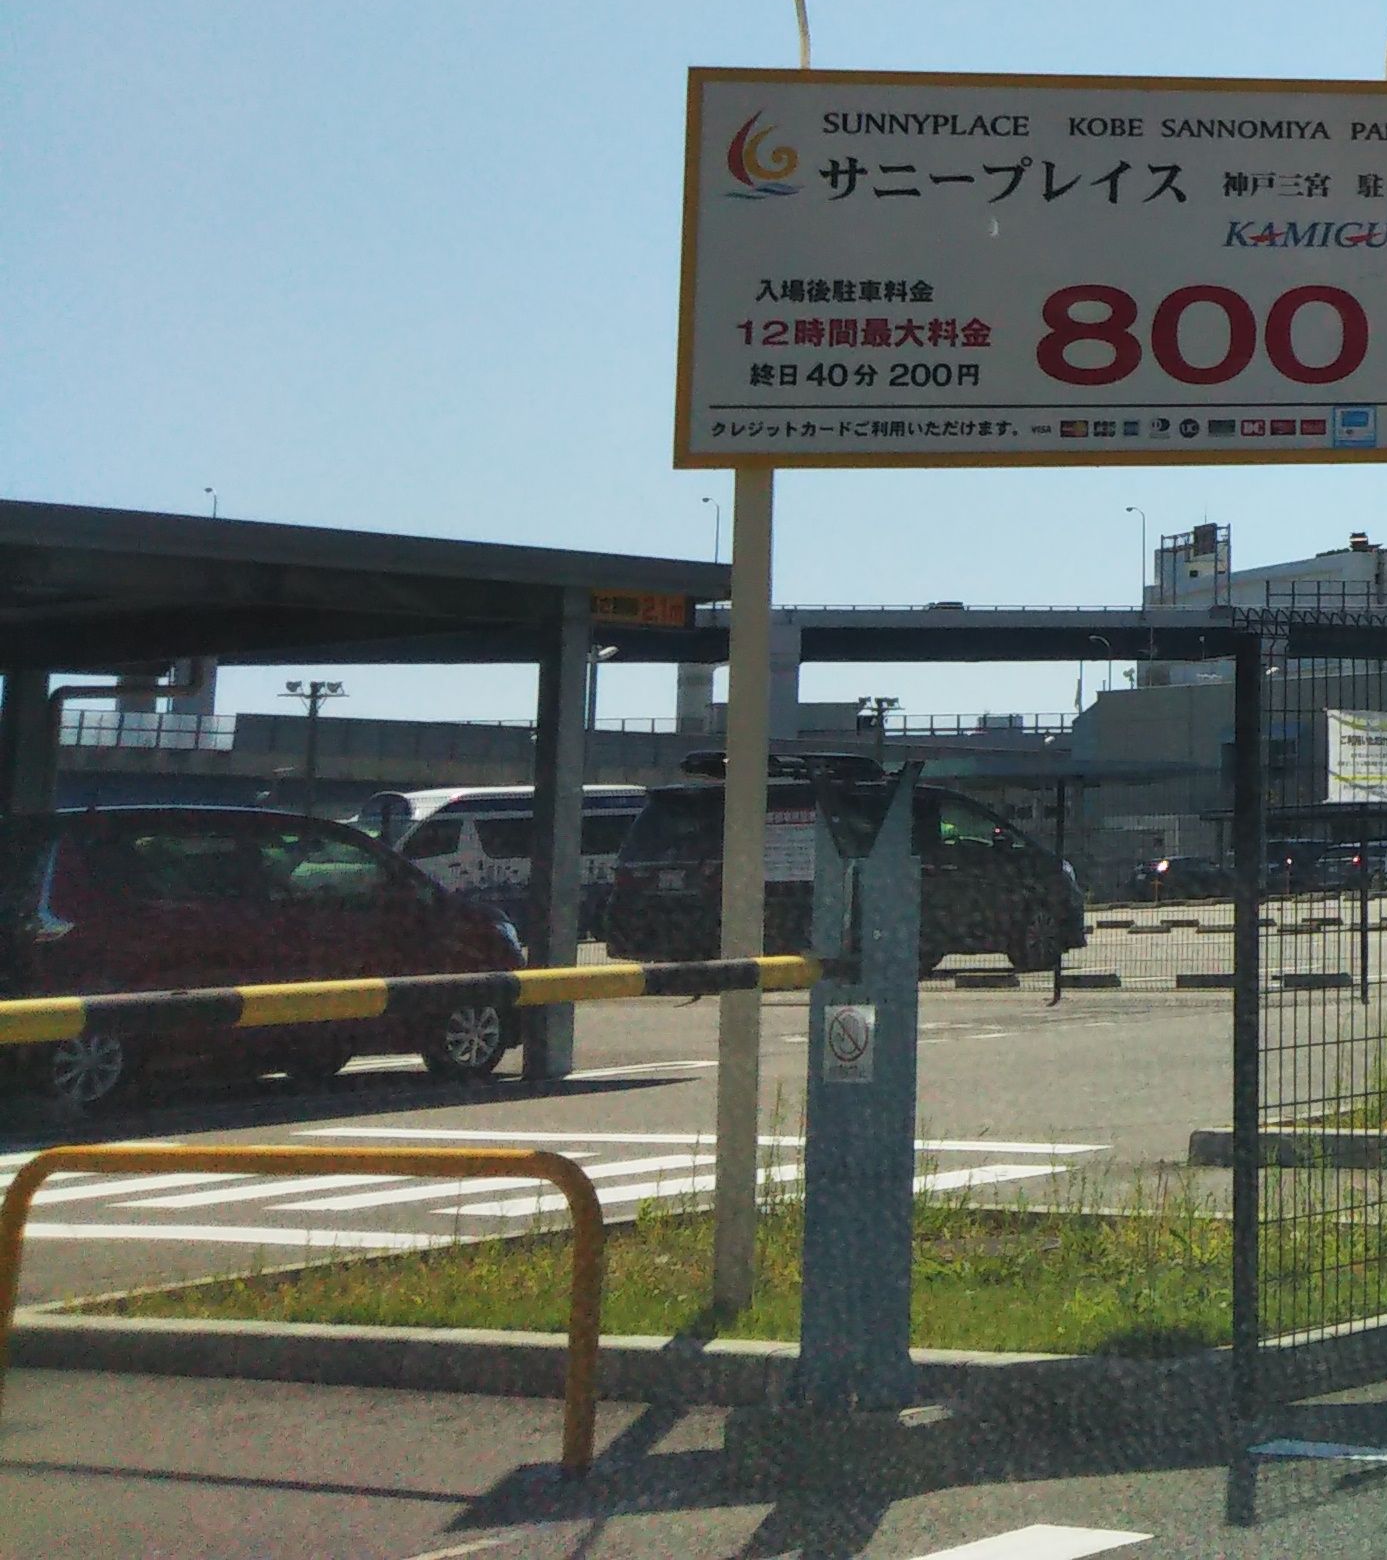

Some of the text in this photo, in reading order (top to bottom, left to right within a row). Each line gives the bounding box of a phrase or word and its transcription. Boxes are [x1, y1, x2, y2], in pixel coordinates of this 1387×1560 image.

[823, 111, 1030, 137] SUNNYPLACE
[1069, 117, 1144, 138] KOBE
[1161, 118, 1331, 140] SANNOMIYA
[819, 156, 1188, 204] サニープレイス
[1222, 172, 1332, 198] 神戸三宮
[756, 279, 935, 303] 入場後駐車料金
[737, 318, 993, 348] 12時間最大料金
[1036, 284, 1370, 387] 800
